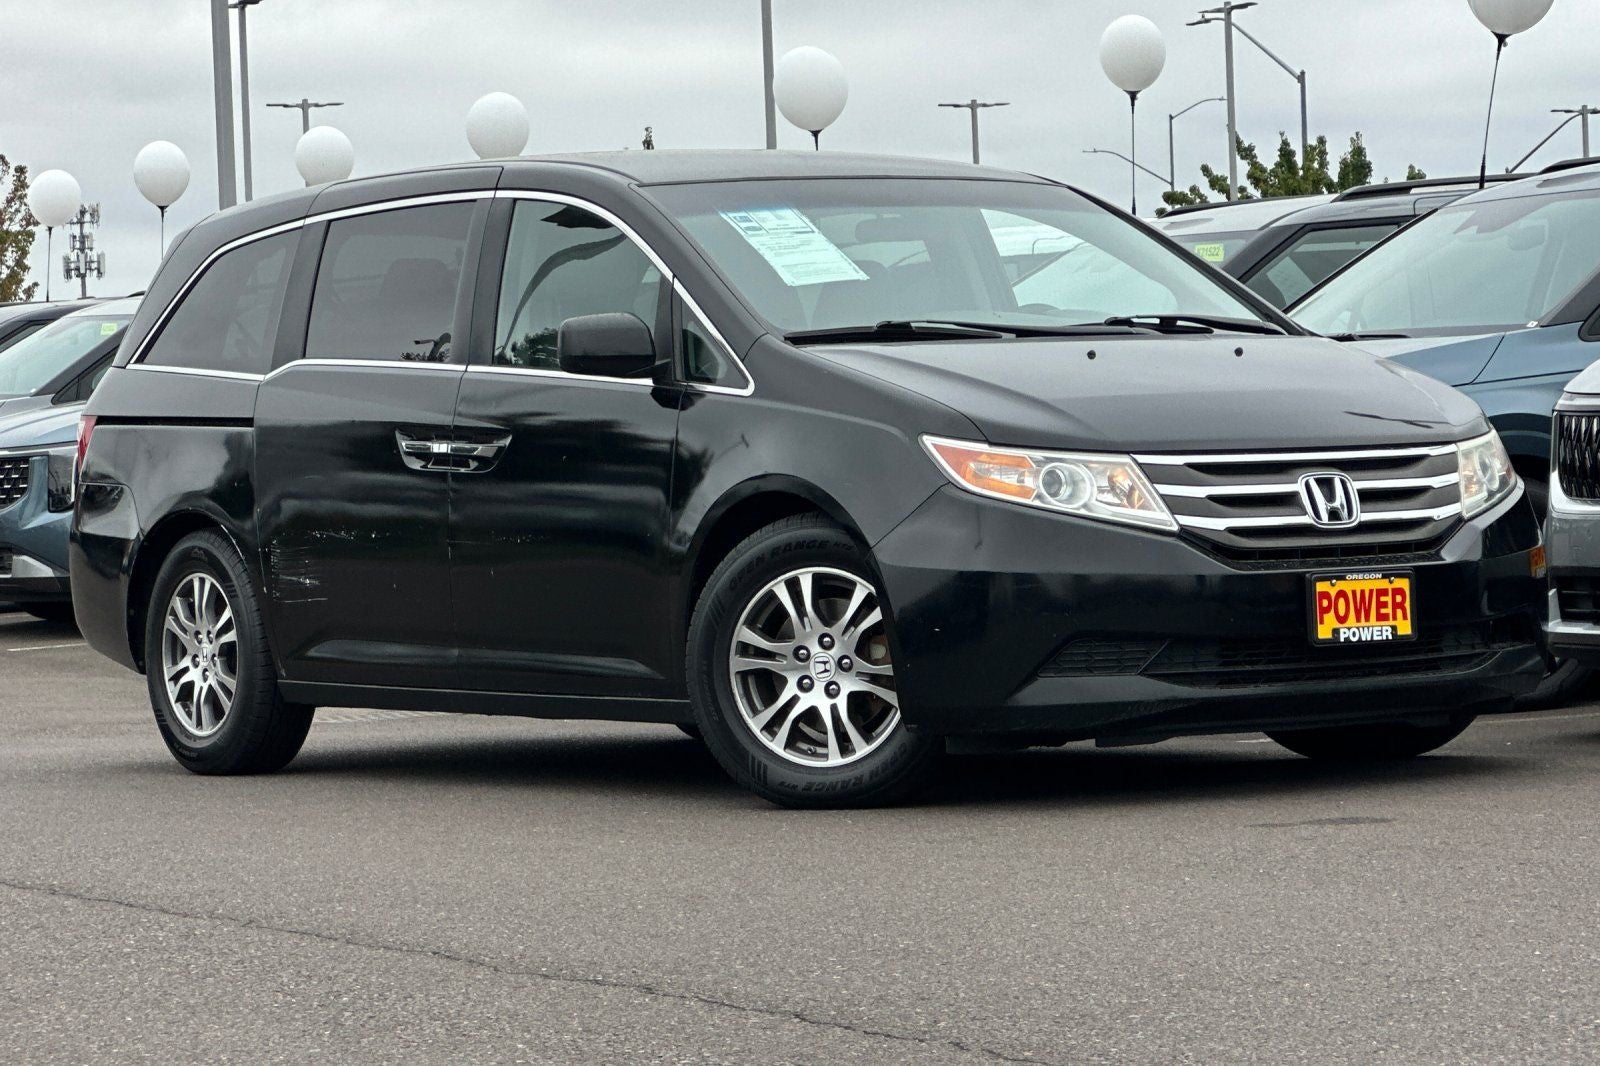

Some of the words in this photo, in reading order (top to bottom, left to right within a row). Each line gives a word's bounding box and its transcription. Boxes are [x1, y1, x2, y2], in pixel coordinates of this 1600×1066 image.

[771, 539, 831, 557] RANGE
[1317, 587, 1408, 625] POWER
[1339, 626, 1393, 642] POWER
